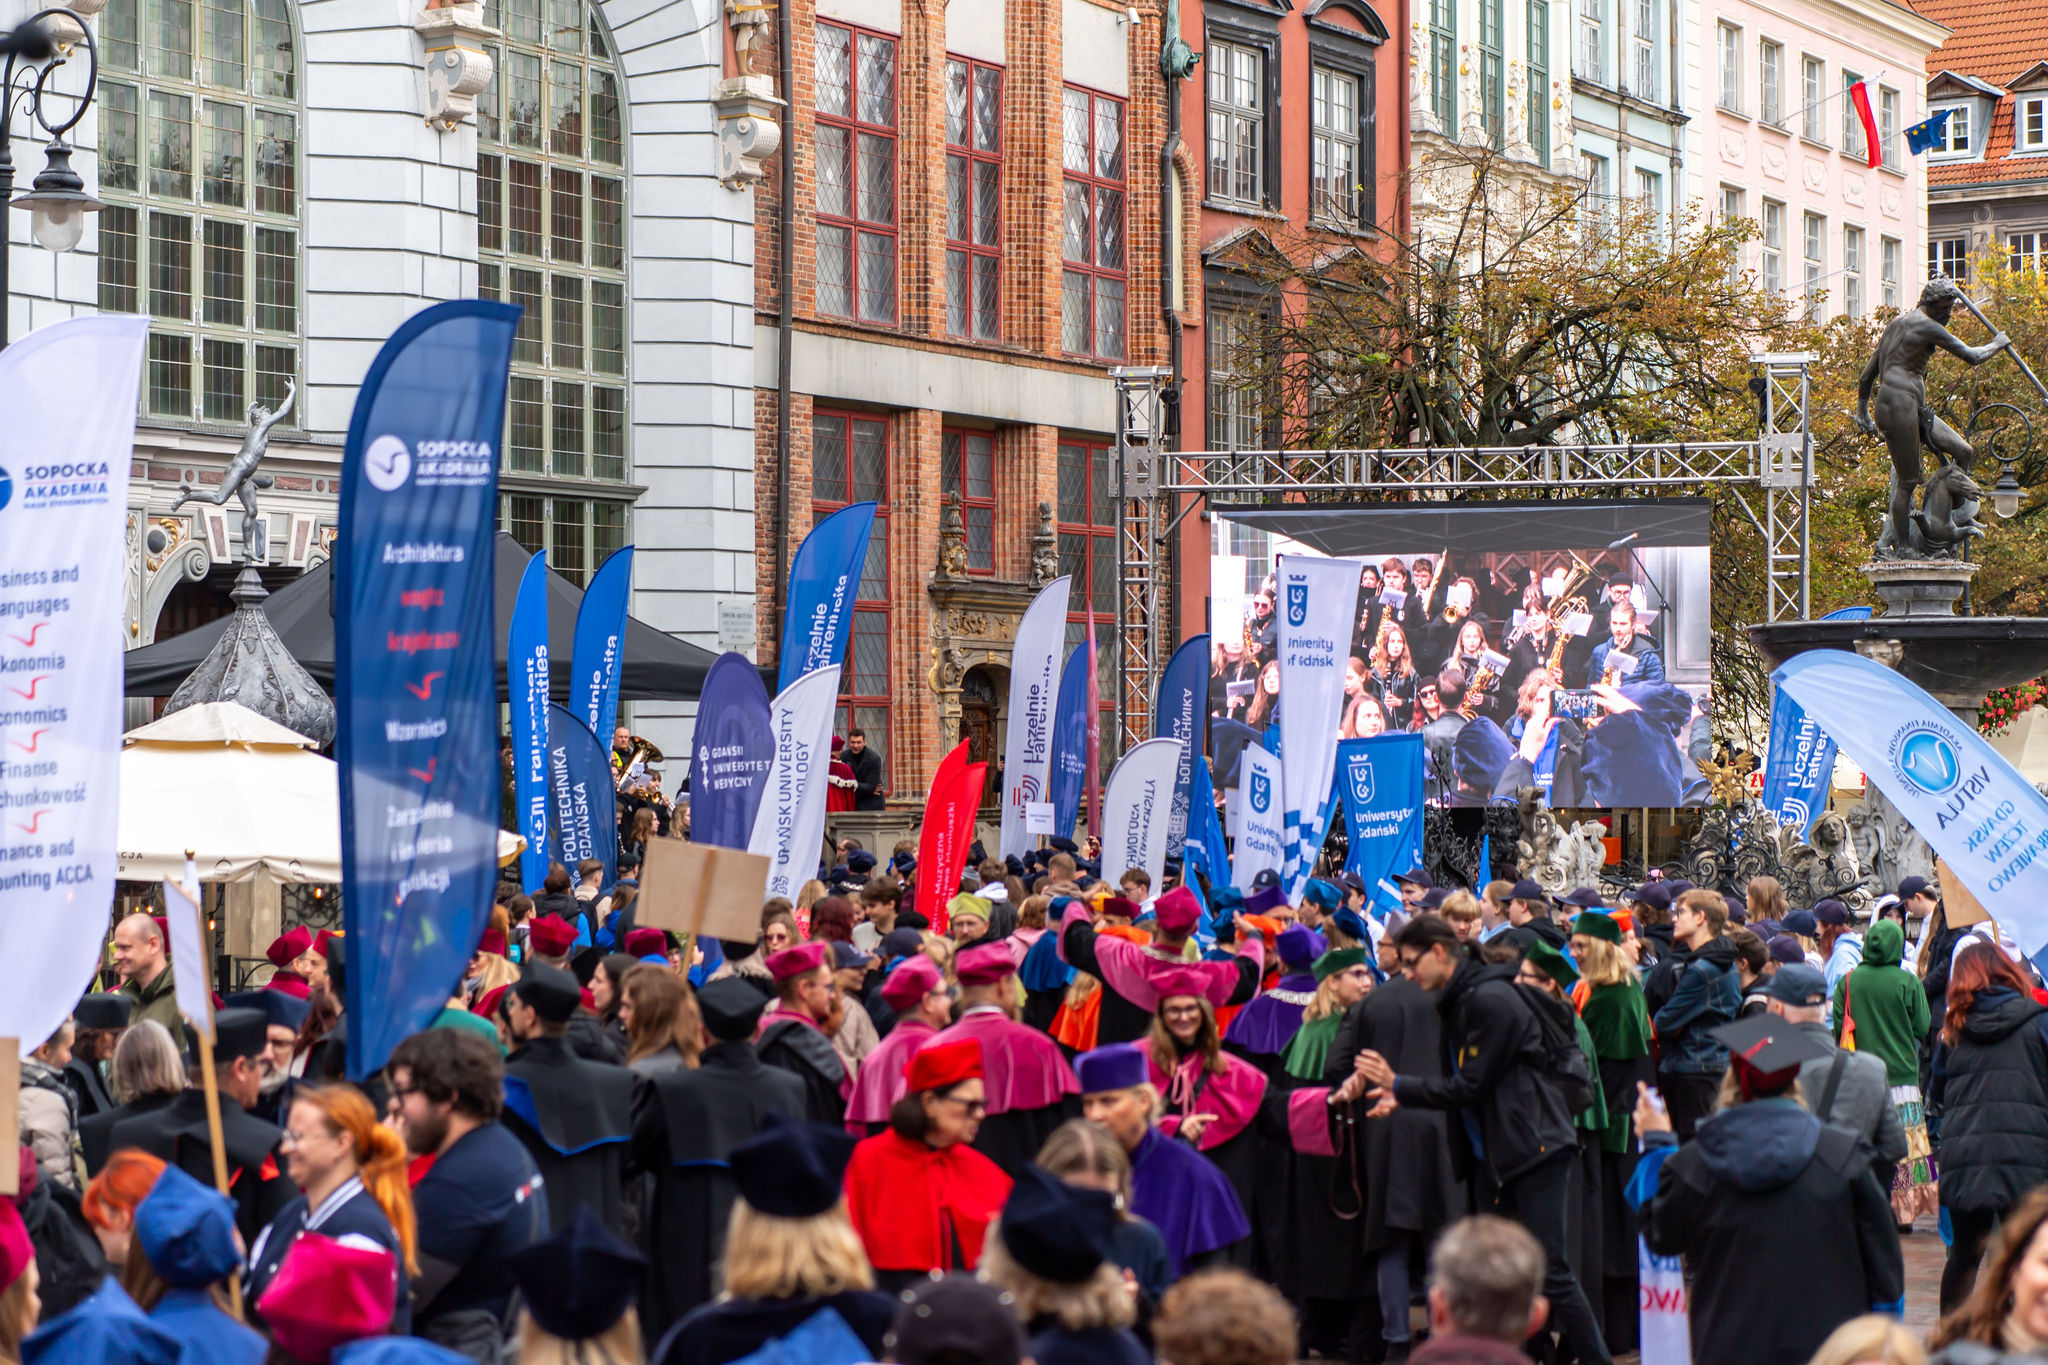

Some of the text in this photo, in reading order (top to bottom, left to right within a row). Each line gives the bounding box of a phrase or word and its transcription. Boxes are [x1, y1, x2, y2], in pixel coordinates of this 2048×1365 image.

[24, 462, 109, 480] SOPOCKA
[24, 482, 108, 499] AKADEMIA
[52, 565, 79, 583] and
[779, 708, 793, 803] UNIVERSITY
[552, 746, 578, 863] POLITECHNIKA
[573, 782, 592, 861] GDAŃSKA
[1356, 808, 1413, 823] Uniwersyt
[50, 837, 75, 857] and
[118, 851, 143, 860] CJA
[935, 832, 945, 894] Muzyczna
[56, 864, 93, 884] ACCA
